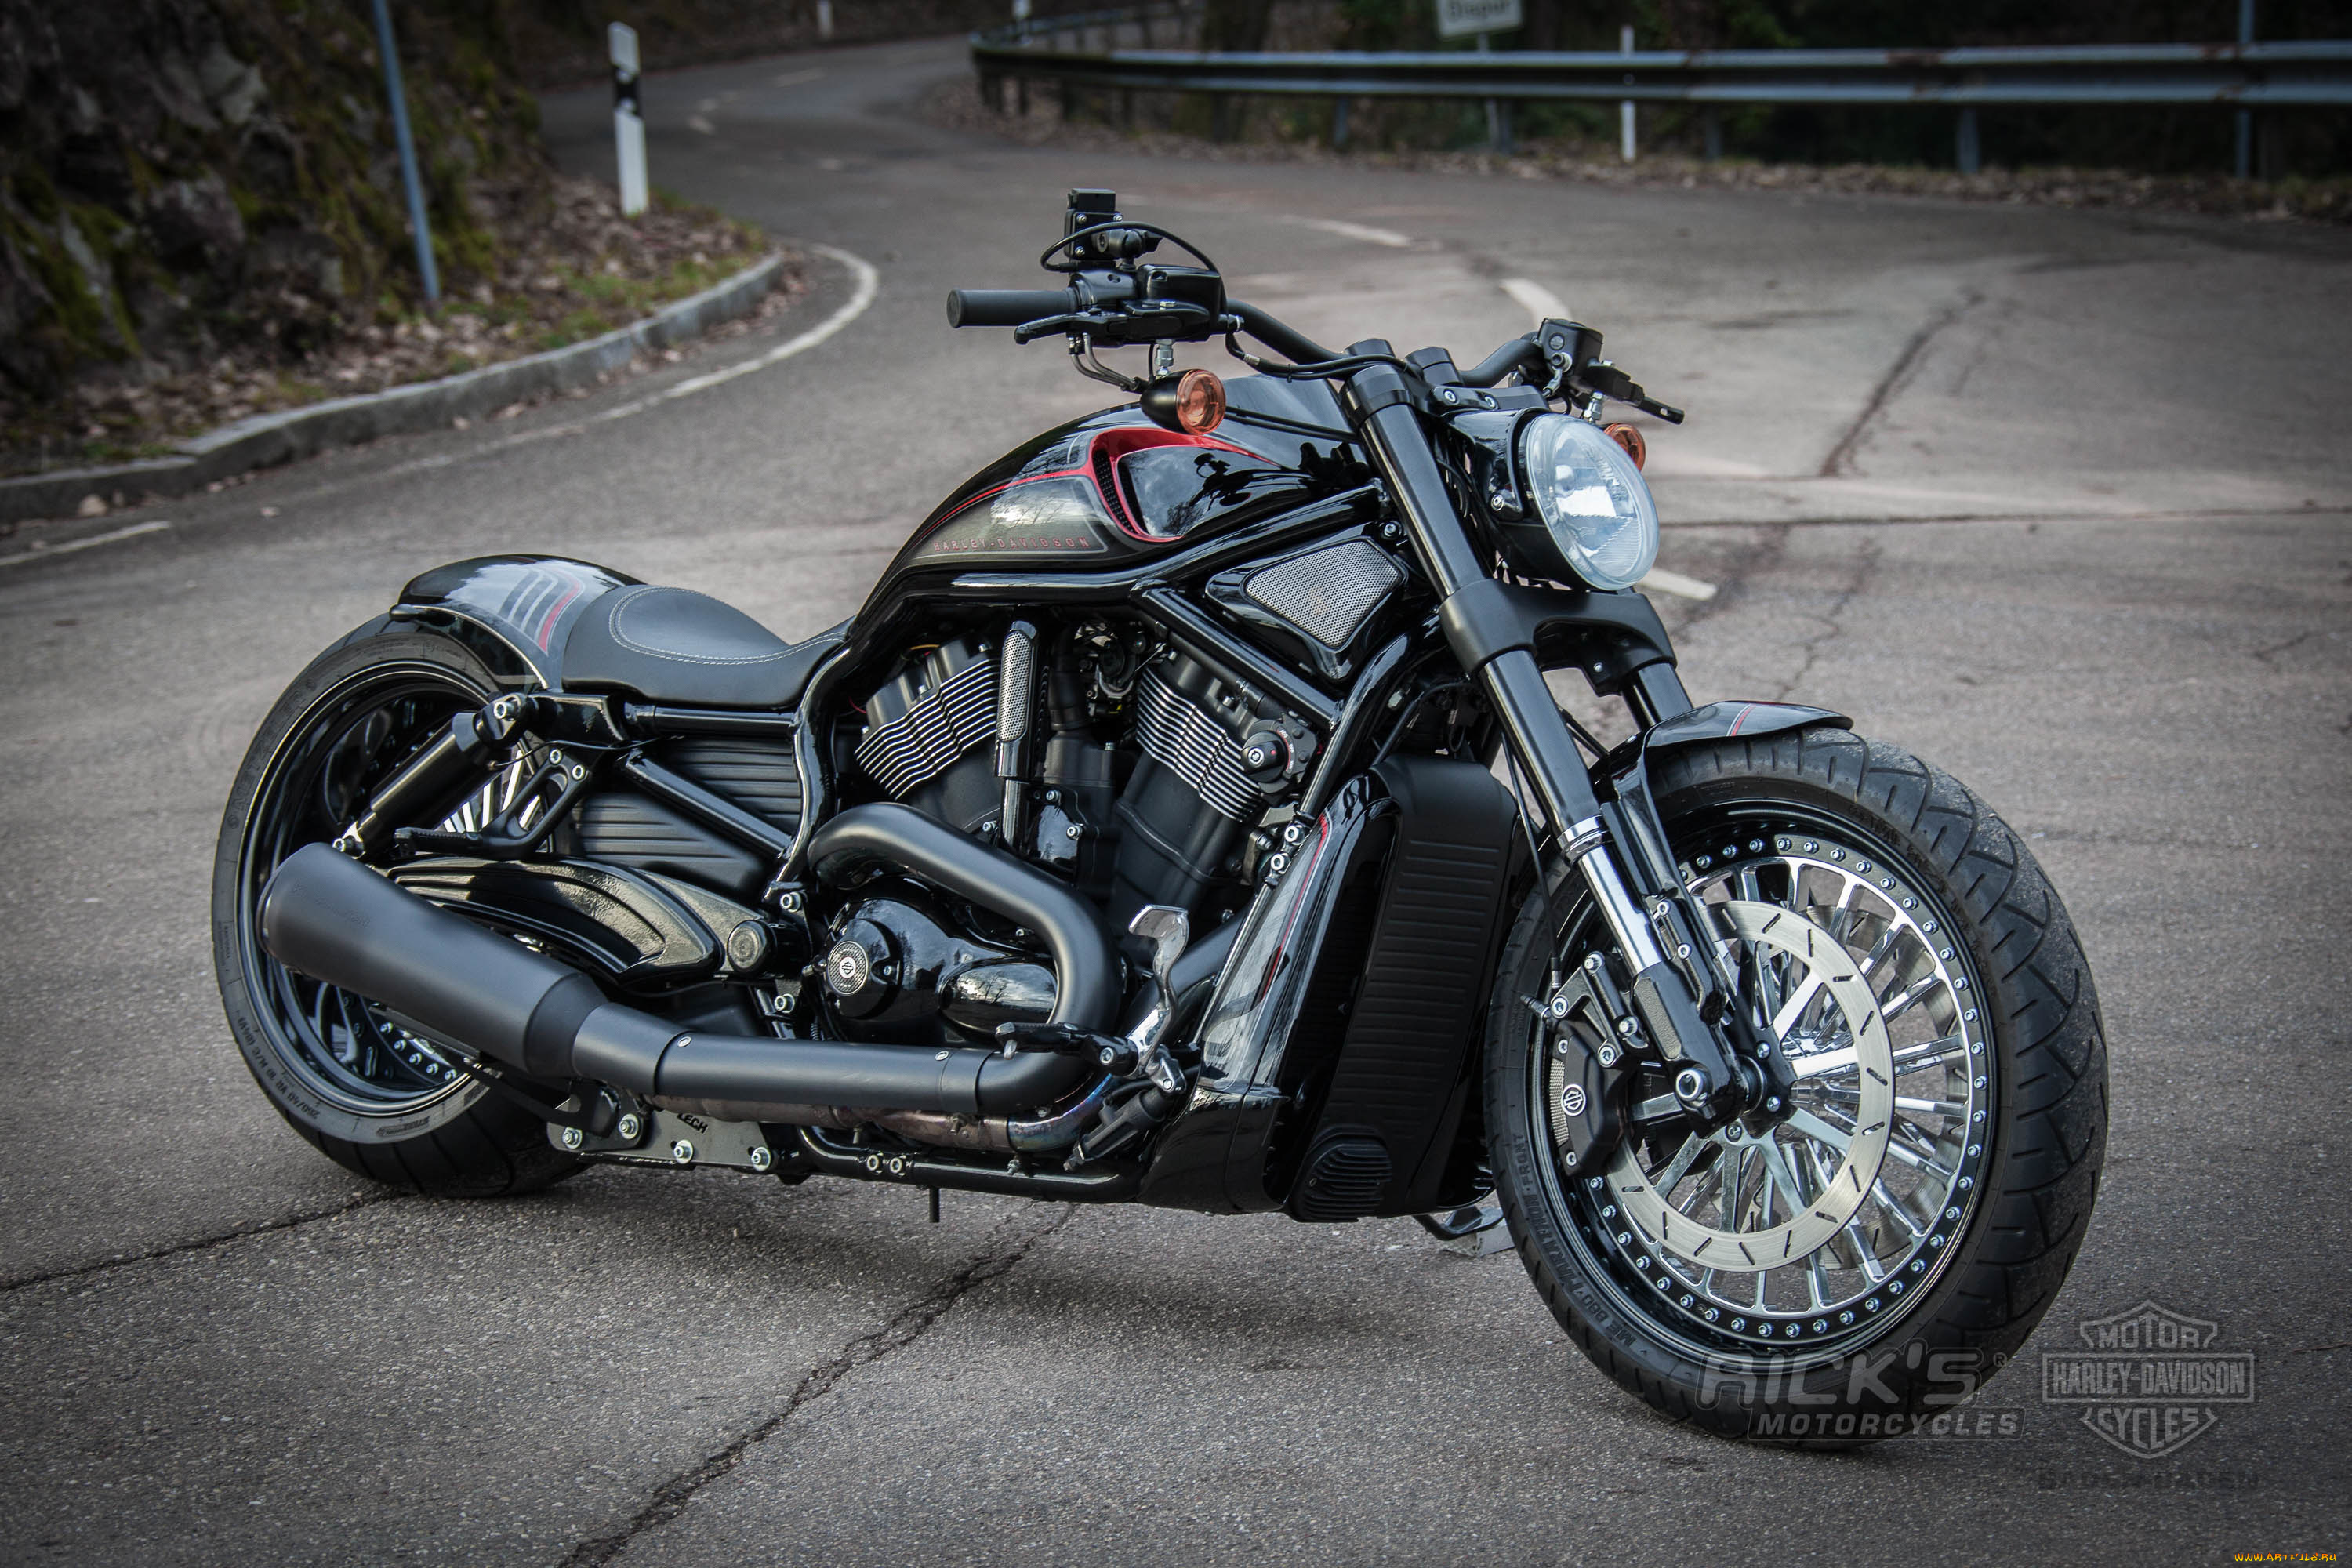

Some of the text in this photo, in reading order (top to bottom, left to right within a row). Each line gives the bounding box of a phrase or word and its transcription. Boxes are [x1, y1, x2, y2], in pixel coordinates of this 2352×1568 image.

[934, 536, 1091, 552] HARLEY-DAVIDSON
[1512, 1134, 1534, 1187] FRONT
[1582, 1293, 1609, 1324] 880
[1606, 1319, 1637, 1347] ME
